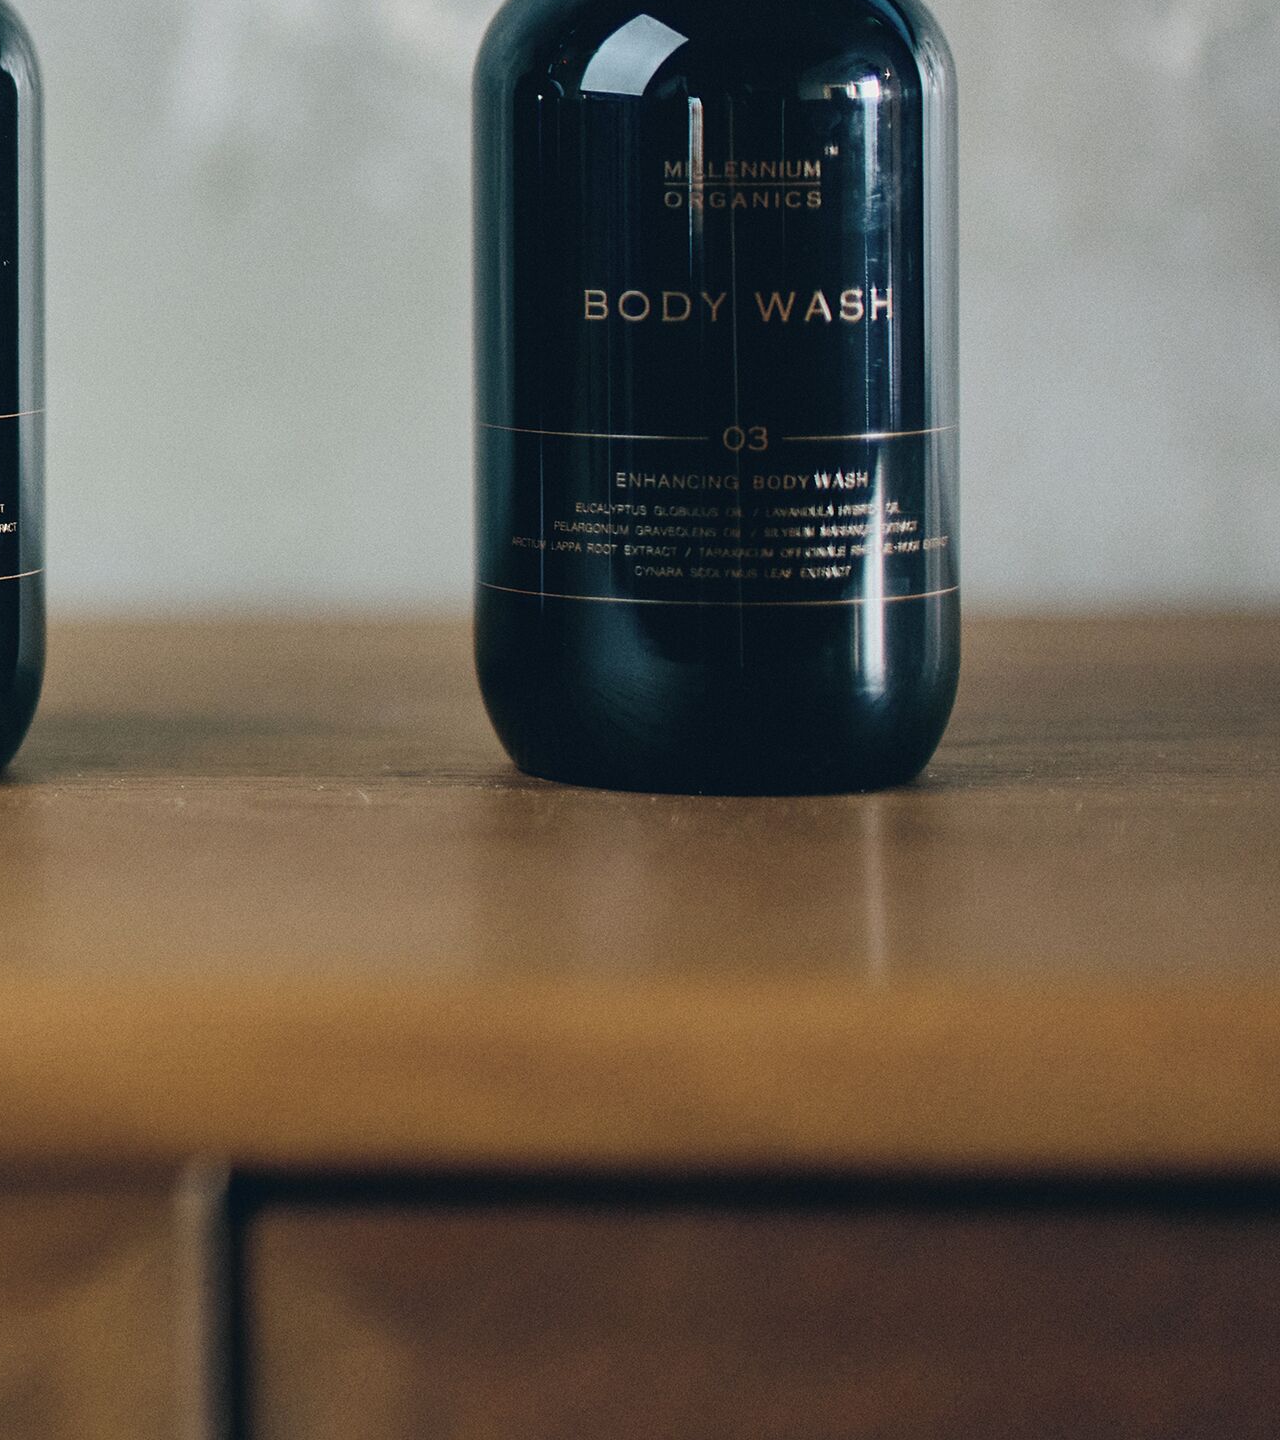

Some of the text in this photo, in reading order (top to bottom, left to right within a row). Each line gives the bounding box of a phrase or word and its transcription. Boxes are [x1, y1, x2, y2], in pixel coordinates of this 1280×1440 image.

[664, 160, 821, 178] MILLENNIUM
[664, 191, 822, 209] ORGANICS
[584, 288, 893, 323] BODY WASH
[722, 426, 769, 451] 03
[616, 471, 868, 490] ENHANCING BODY WASH
[575, 502, 647, 516] EUCALYPTUS
[554, 521, 629, 536] PELARGONIUM
[551, 541, 582, 552] LAPPA
[587, 543, 618, 554] ROOT
[624, 545, 677, 557] EXTRACT
[634, 565, 684, 577] CYNARA
